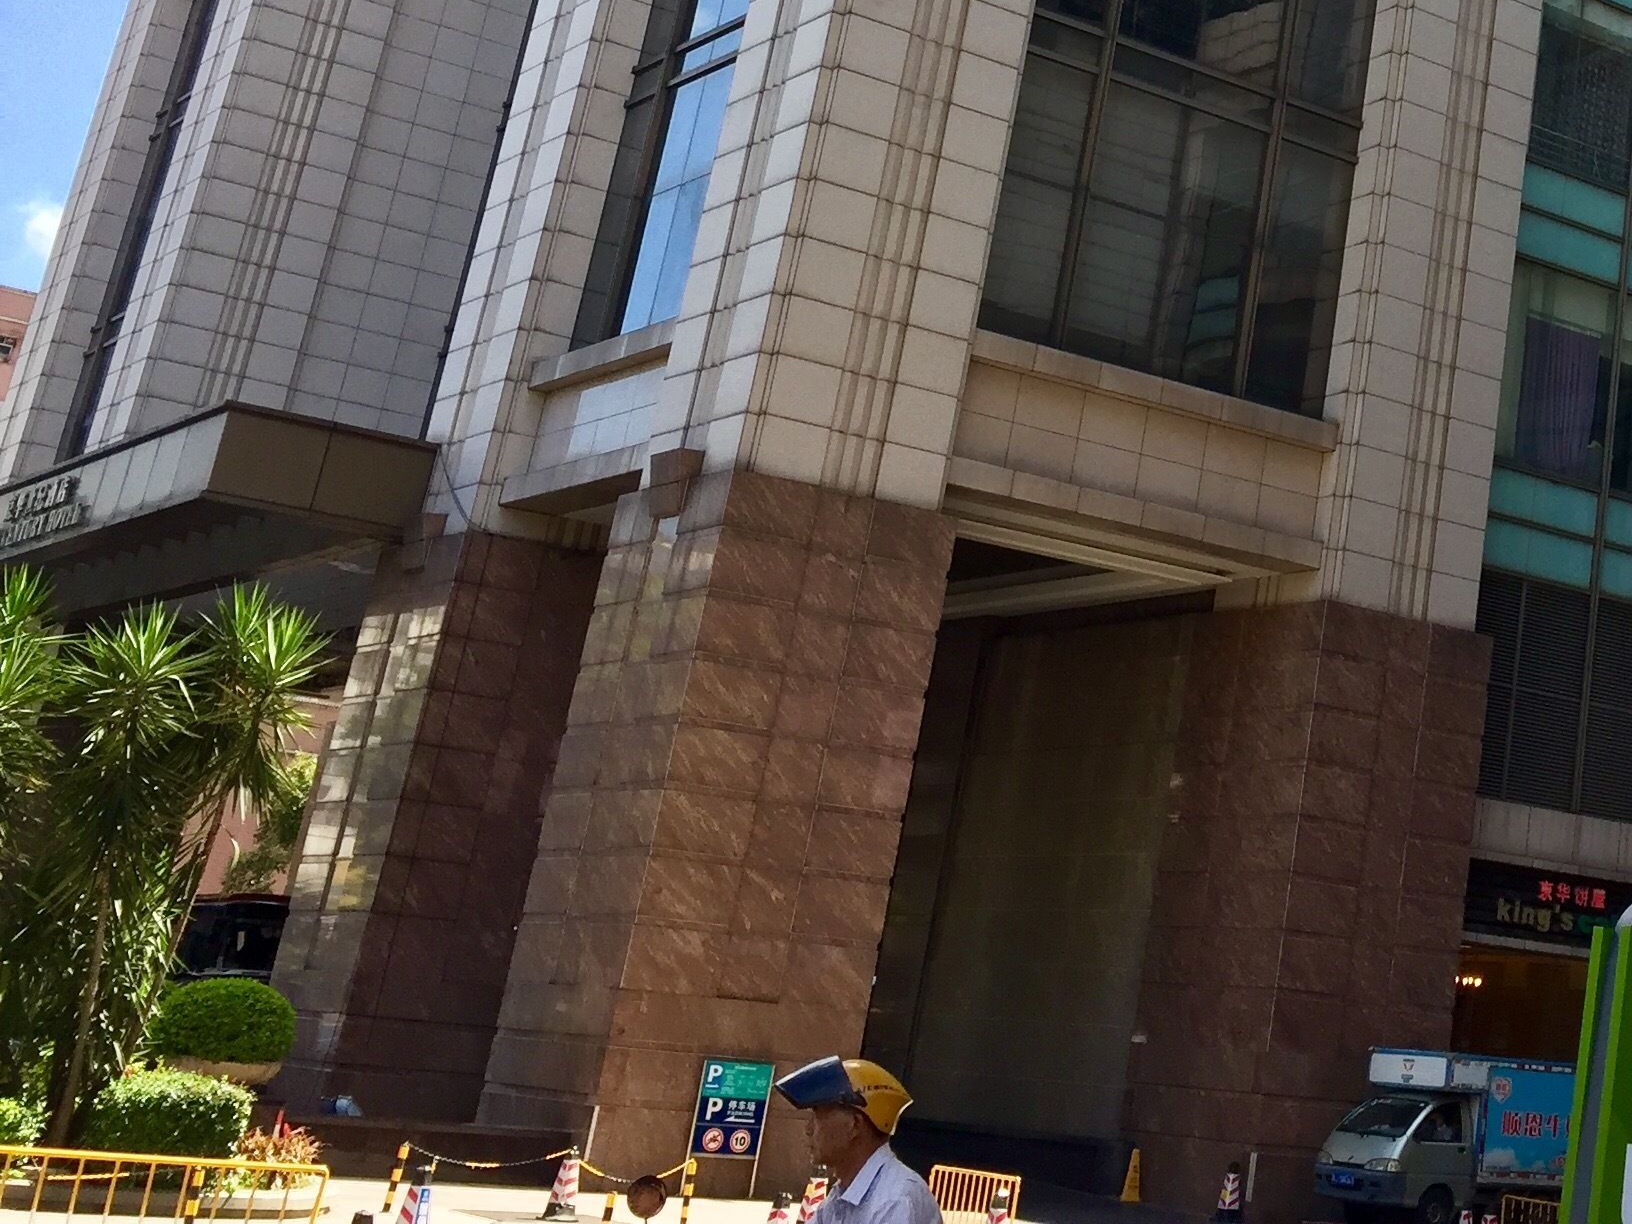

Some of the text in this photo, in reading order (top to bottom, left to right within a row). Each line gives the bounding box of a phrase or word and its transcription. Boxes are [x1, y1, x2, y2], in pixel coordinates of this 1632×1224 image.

[705, 1097, 723, 1121] P
[728, 1099, 756, 1112] 停车场
[1502, 1111, 1570, 1139] 顺恩牛
[734, 1136, 747, 1147] 10
